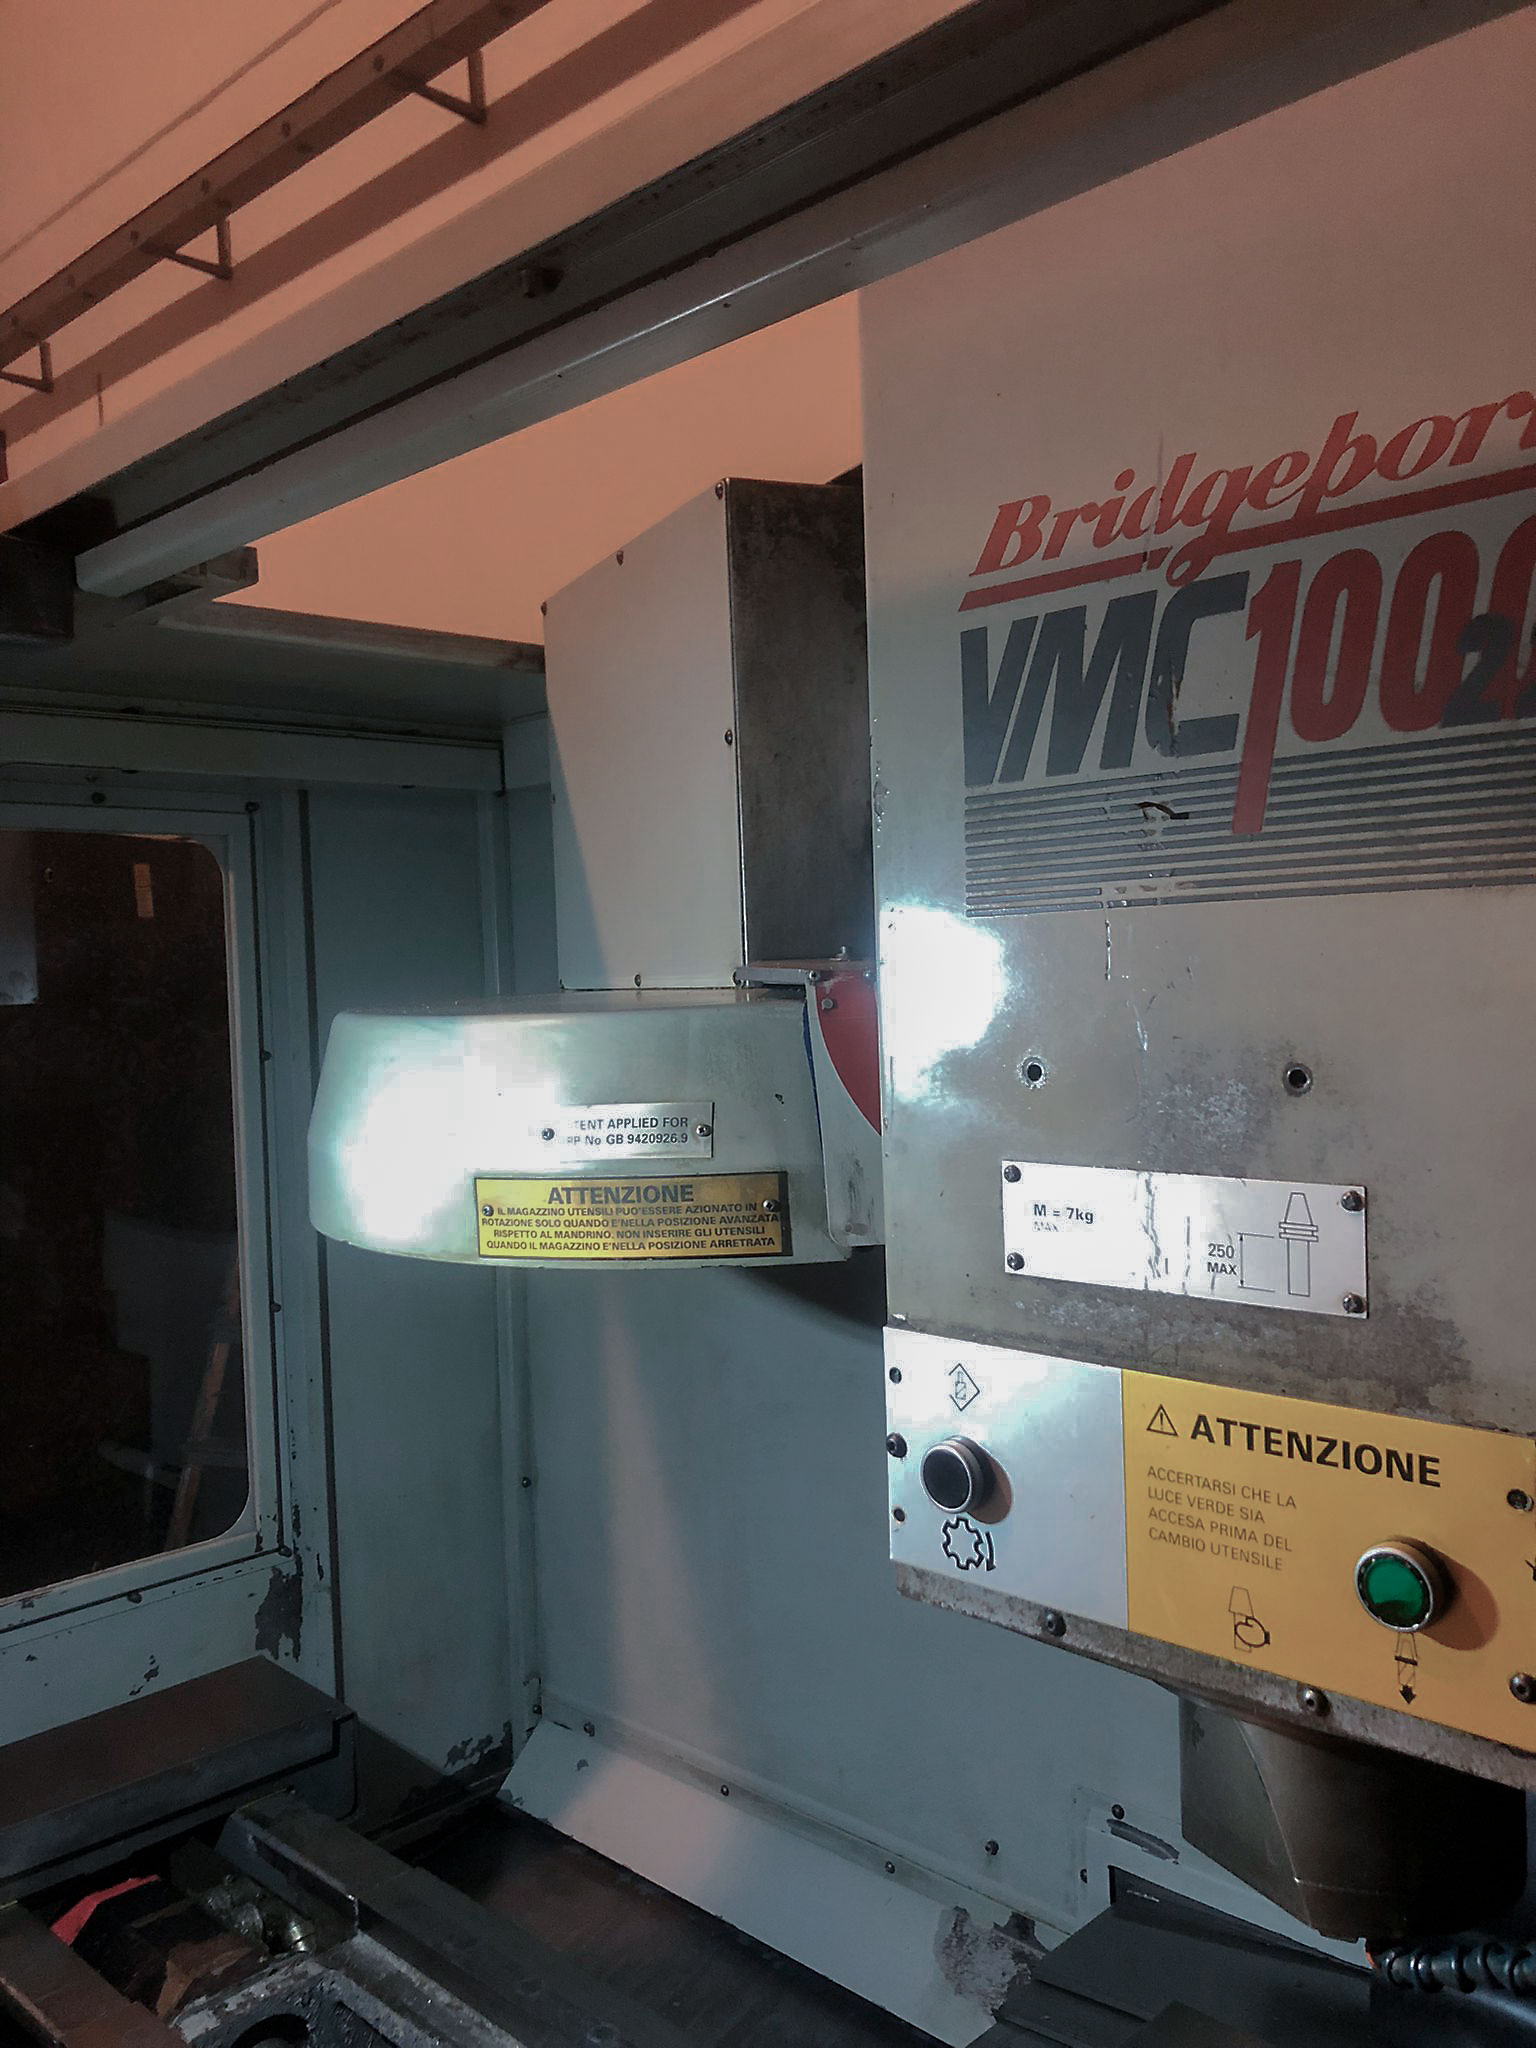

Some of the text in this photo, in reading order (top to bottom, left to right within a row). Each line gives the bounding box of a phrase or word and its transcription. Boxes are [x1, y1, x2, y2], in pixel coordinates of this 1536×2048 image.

[968, 390, 1536, 588] Bridgepor
[607, 1117, 659, 1129] APPLIED
[662, 1117, 688, 1128] FOR
[585, 1135, 602, 1146] No
[606, 1133, 624, 1145] GB
[627, 1132, 688, 1145] 9420926.9
[547, 1184, 695, 1205] ATTENZIONE
[497, 1207, 506, 1216] IL
[507, 1207, 565, 1216] MAGAZZINO
[567, 1207, 613, 1216] UTENSILI
[685, 1203, 742, 1214] AZIONATO
[745, 1202, 757, 1211] IN
[1033, 1203, 1047, 1217] M
[1066, 1206, 1094, 1225] 7kg
[481, 1218, 533, 1227] ROTAZIONE
[535, 1218, 561, 1228] SOLO
[563, 1219, 608, 1228] QUANDO
[657, 1216, 716, 1227] POSIZIONE
[719, 1213, 779, 1224] AVANZATA
[493, 1229, 538, 1238] RISPETTO
[540, 1230, 551, 1239] AL
[616, 1229, 640, 1239] NON
[643, 1228, 692, 1238] INSERIRE
[694, 1227, 712, 1237] GLI
[714, 1226, 766, 1236] UTENSILI
[486, 1240, 527, 1250] QUANDO
[529, 1241, 537, 1250] IL
[539, 1241, 601, 1250] MAGAZZINO
[648, 1239, 707, 1250] POSIZIONE
[709, 1237, 775, 1248] ARRETRATA
[1207, 1242, 1235, 1259] 250
[1207, 1261, 1238, 1276] MAX
[1190, 1413, 1441, 1488] ATTENZIONE
[1147, 1465, 1298, 1510] ACCERTARSI CHE LA
[1147, 1486, 1266, 1524] LUCE VERDE SIA
[1148, 1506, 1293, 1553] ACCESA PRIMA DEL
[1148, 1527, 1283, 1572] CAMBIO UTENSILE
